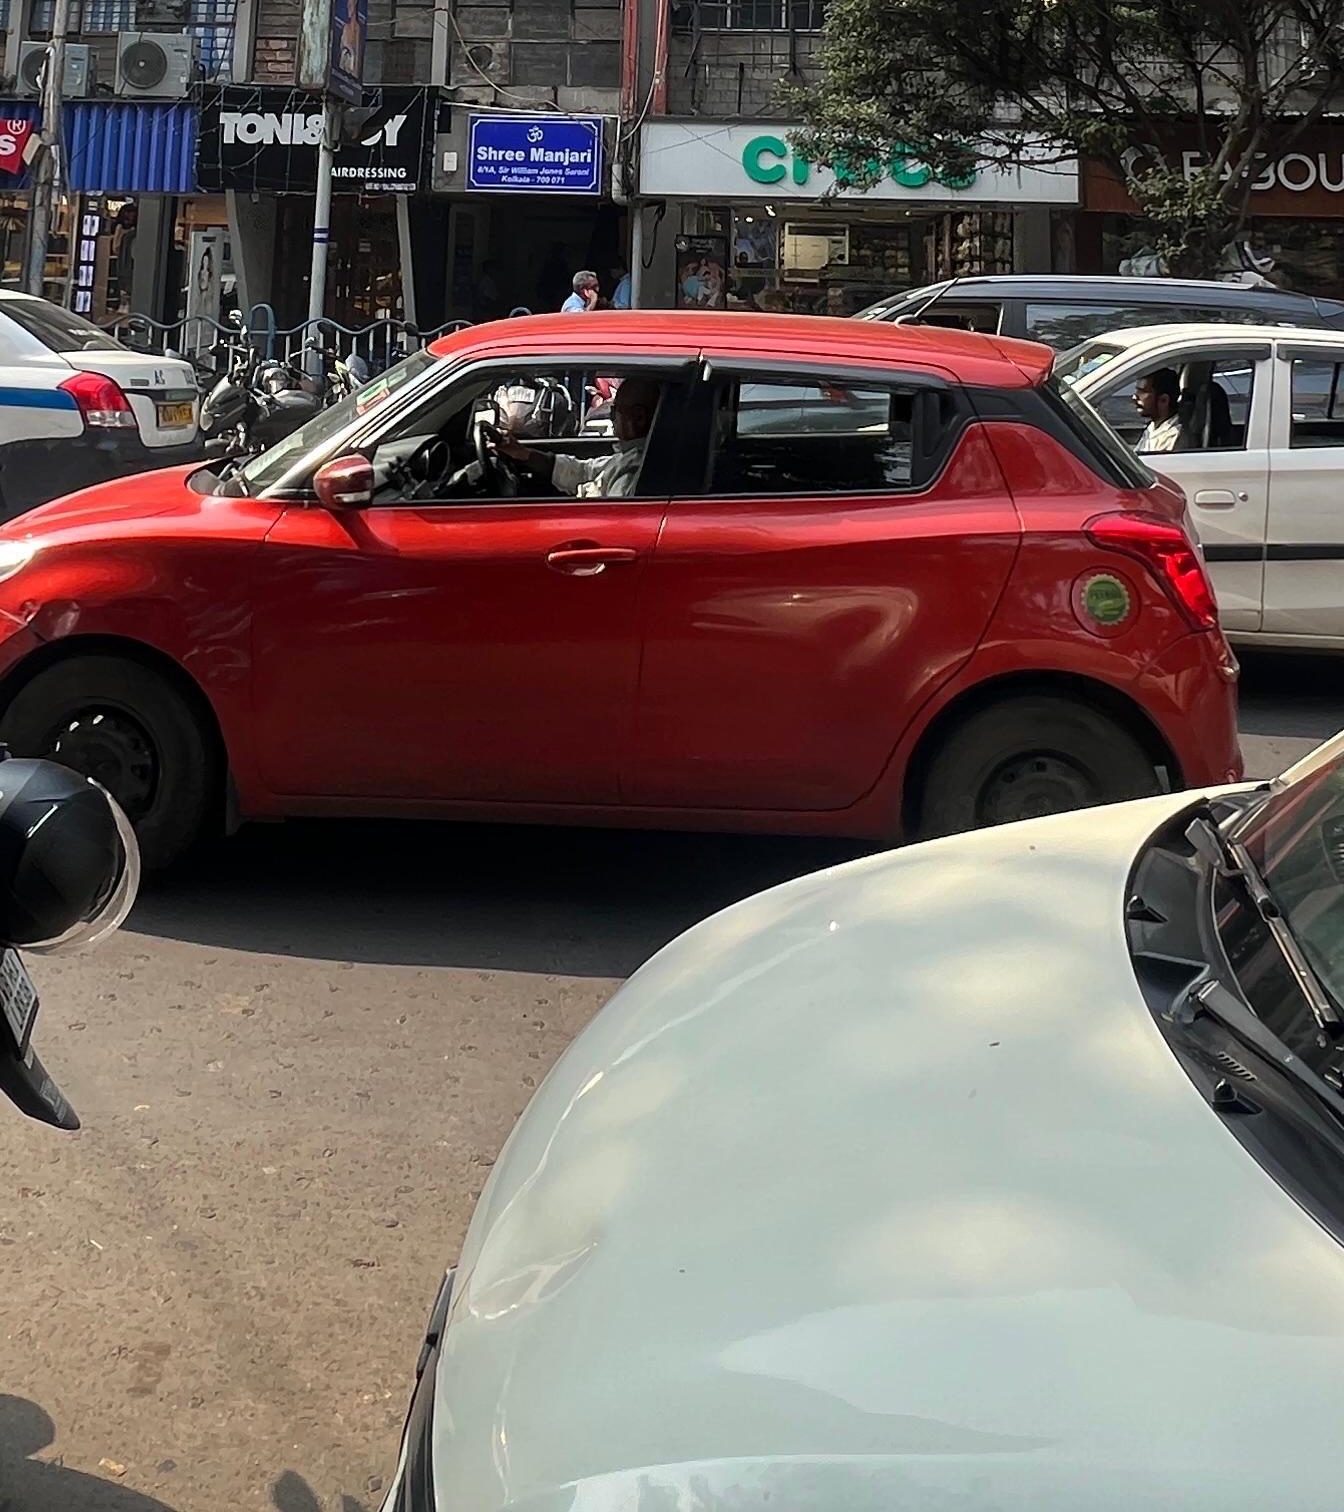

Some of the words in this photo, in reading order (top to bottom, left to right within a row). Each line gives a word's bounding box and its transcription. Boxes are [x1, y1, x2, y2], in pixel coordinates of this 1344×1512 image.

[476, 146, 526, 161] Shree
[530, 147, 592, 166] Manjari
[498, 166, 510, 174] Sir
[511, 166, 538, 175] William
[501, 175, 530, 183] Kolkata
[536, 176, 550, 184] 700
[551, 176, 565, 184] 071
